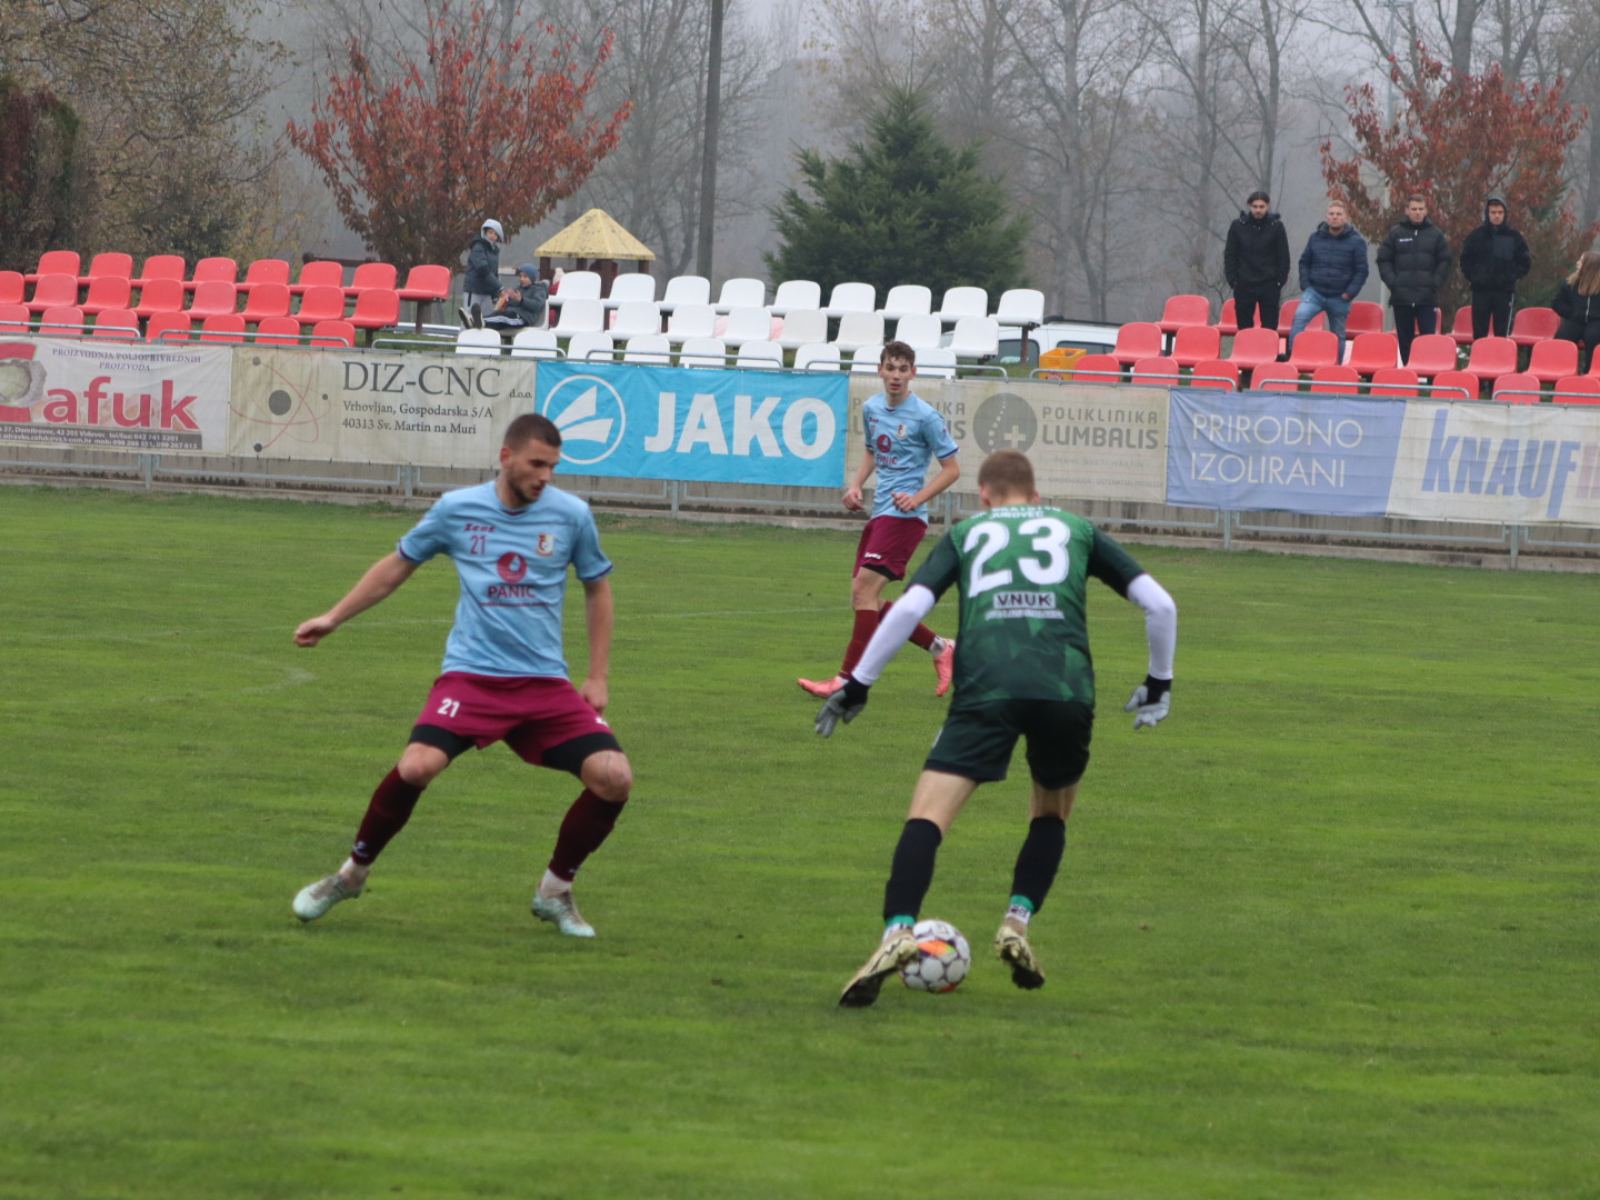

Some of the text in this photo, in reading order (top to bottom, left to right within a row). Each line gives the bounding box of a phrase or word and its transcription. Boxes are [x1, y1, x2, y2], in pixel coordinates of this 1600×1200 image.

[98, 361, 152, 373] PROIZVODA
[342, 361, 533, 400] DIZ-CNC d.o.o.
[343, 400, 493, 419] Vrhovljan, Gospodarska 5/A
[1042, 405, 1159, 425] POLIKLINIKA
[342, 419, 477, 435] 40313 Sv. Martin na Muri
[644, 392, 836, 460] JAKO
[1191, 411, 1364, 449] PRIRODNO
[1041, 426, 1160, 450] LUMBALIS
[1190, 451, 1346, 489] IZOLIRANI
[1421, 408, 1582, 519] KNAUF
[469, 534, 488, 554] 21
[962, 517, 1072, 598] 23
[997, 593, 1051, 607] VNUK
[437, 697, 461, 718] 21
